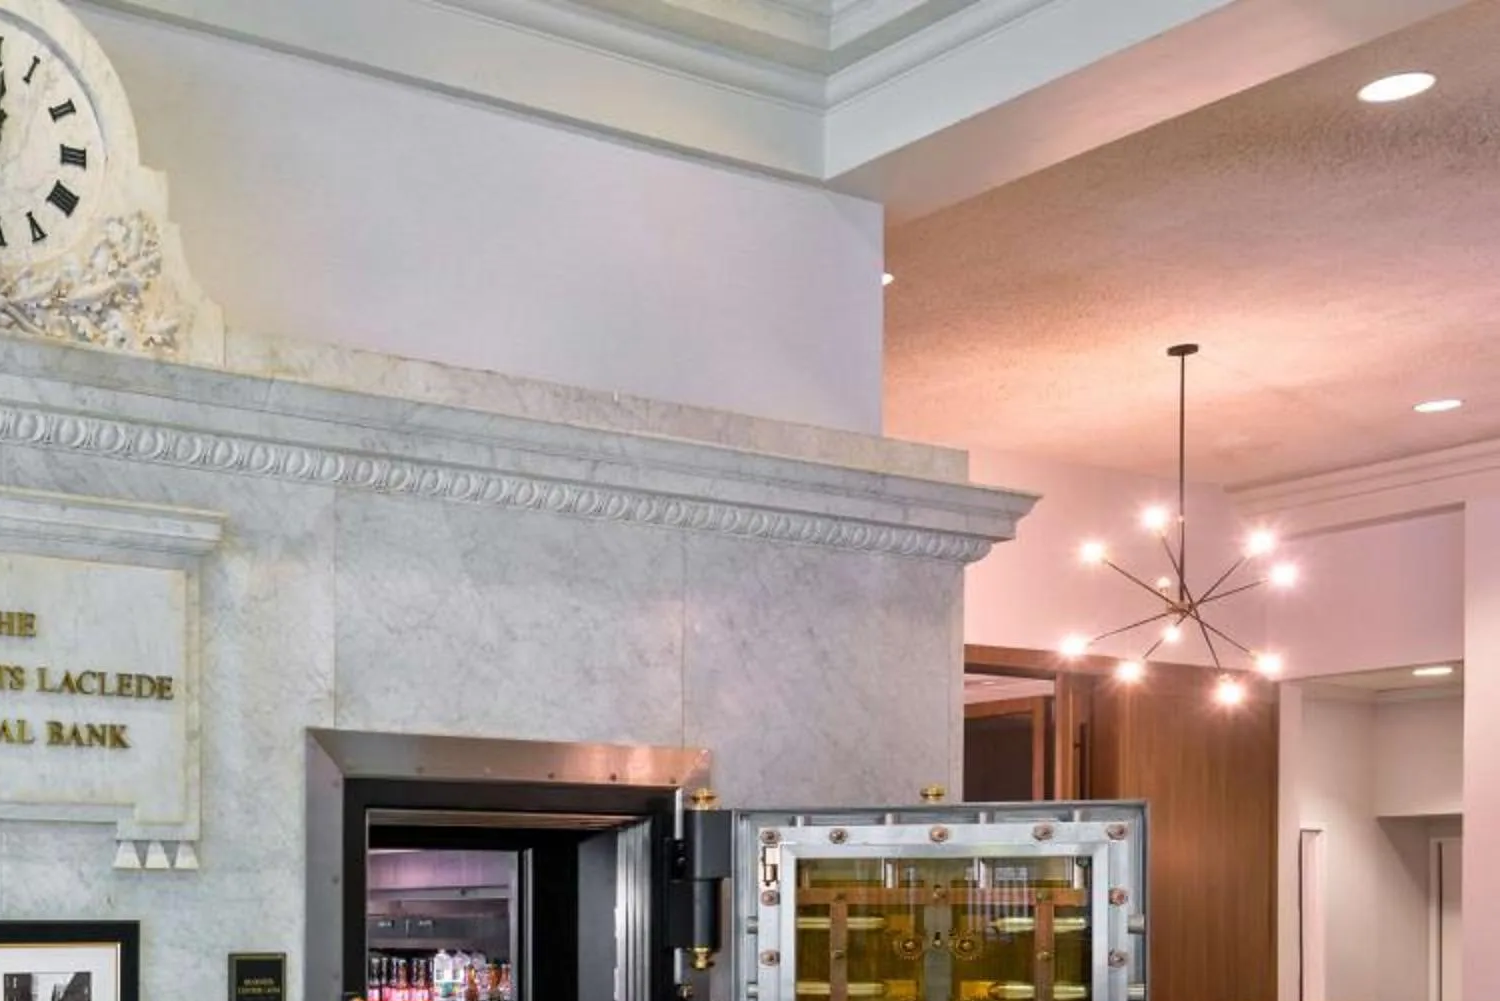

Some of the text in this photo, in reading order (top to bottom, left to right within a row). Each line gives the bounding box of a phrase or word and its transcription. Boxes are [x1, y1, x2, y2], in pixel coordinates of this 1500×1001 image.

[23, 55, 41, 84] I
[49, 98, 76, 122] II
[60, 144, 87, 170] III
[26, 211, 48, 243] V
[37, 667, 174, 700] LACLEDE
[46, 721, 130, 749] BANK
